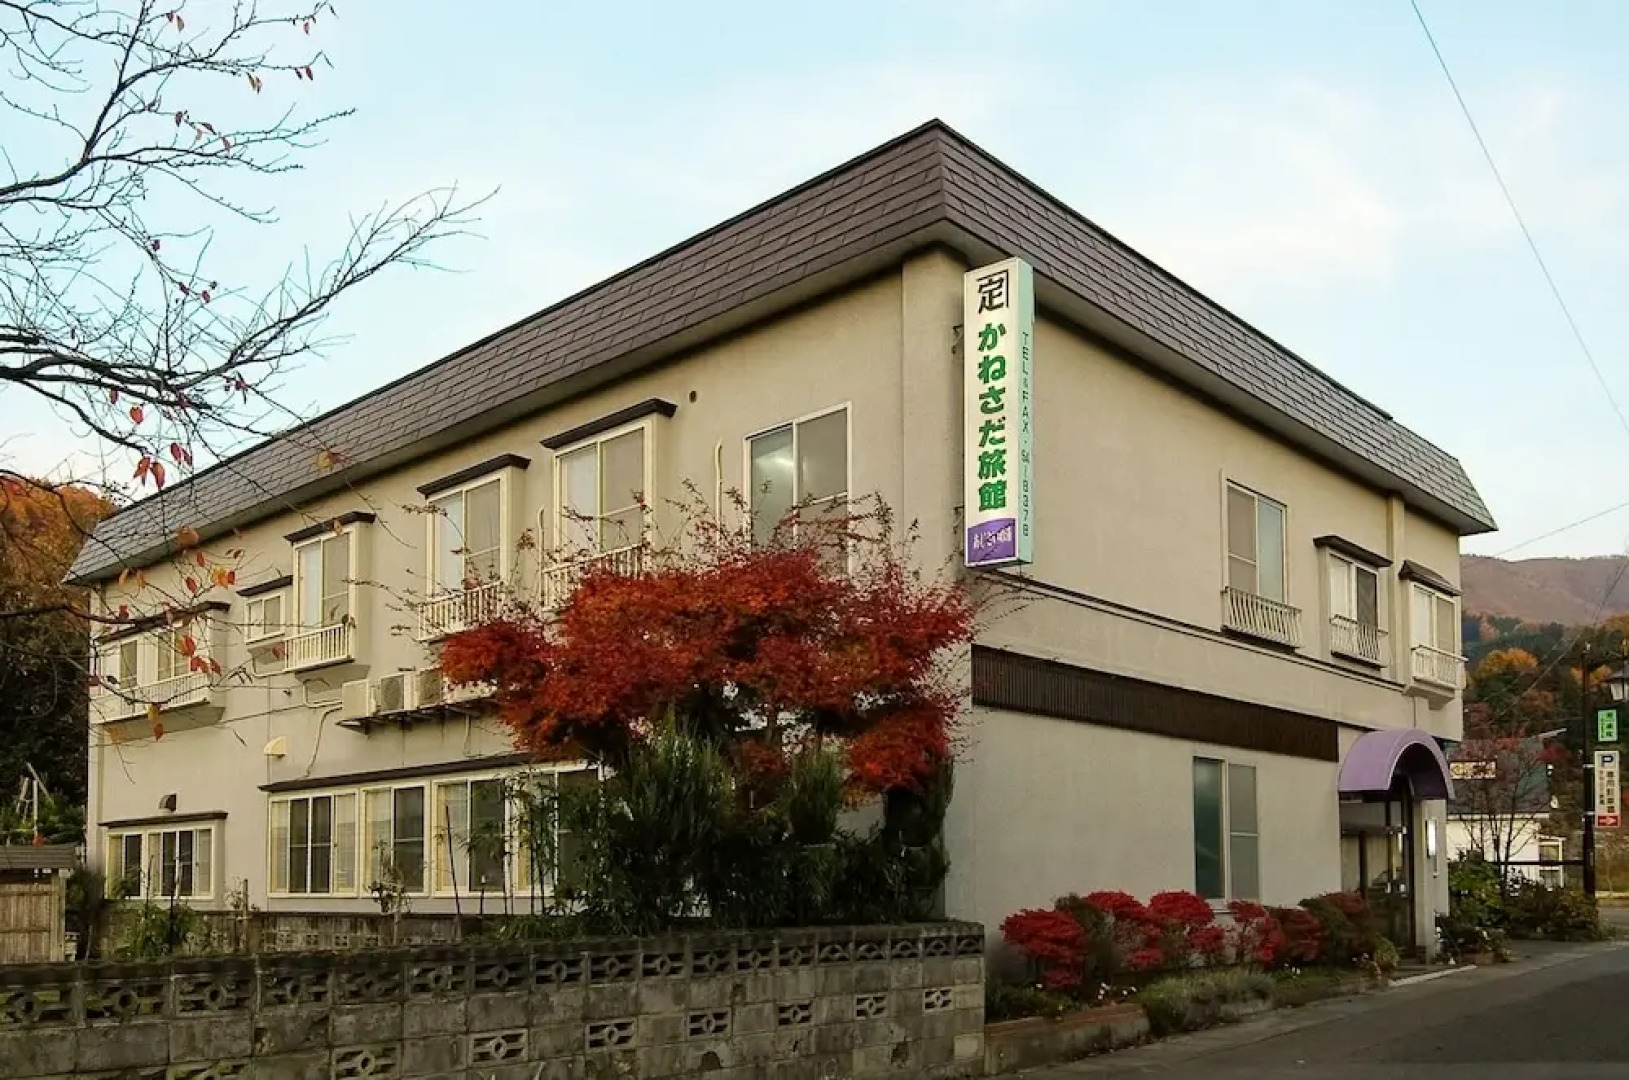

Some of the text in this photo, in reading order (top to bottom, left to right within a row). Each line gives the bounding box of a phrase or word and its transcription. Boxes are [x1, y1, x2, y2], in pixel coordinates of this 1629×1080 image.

[977, 322, 1007, 512] かねさだ旅館
[1601, 755, 1614, 768] P
